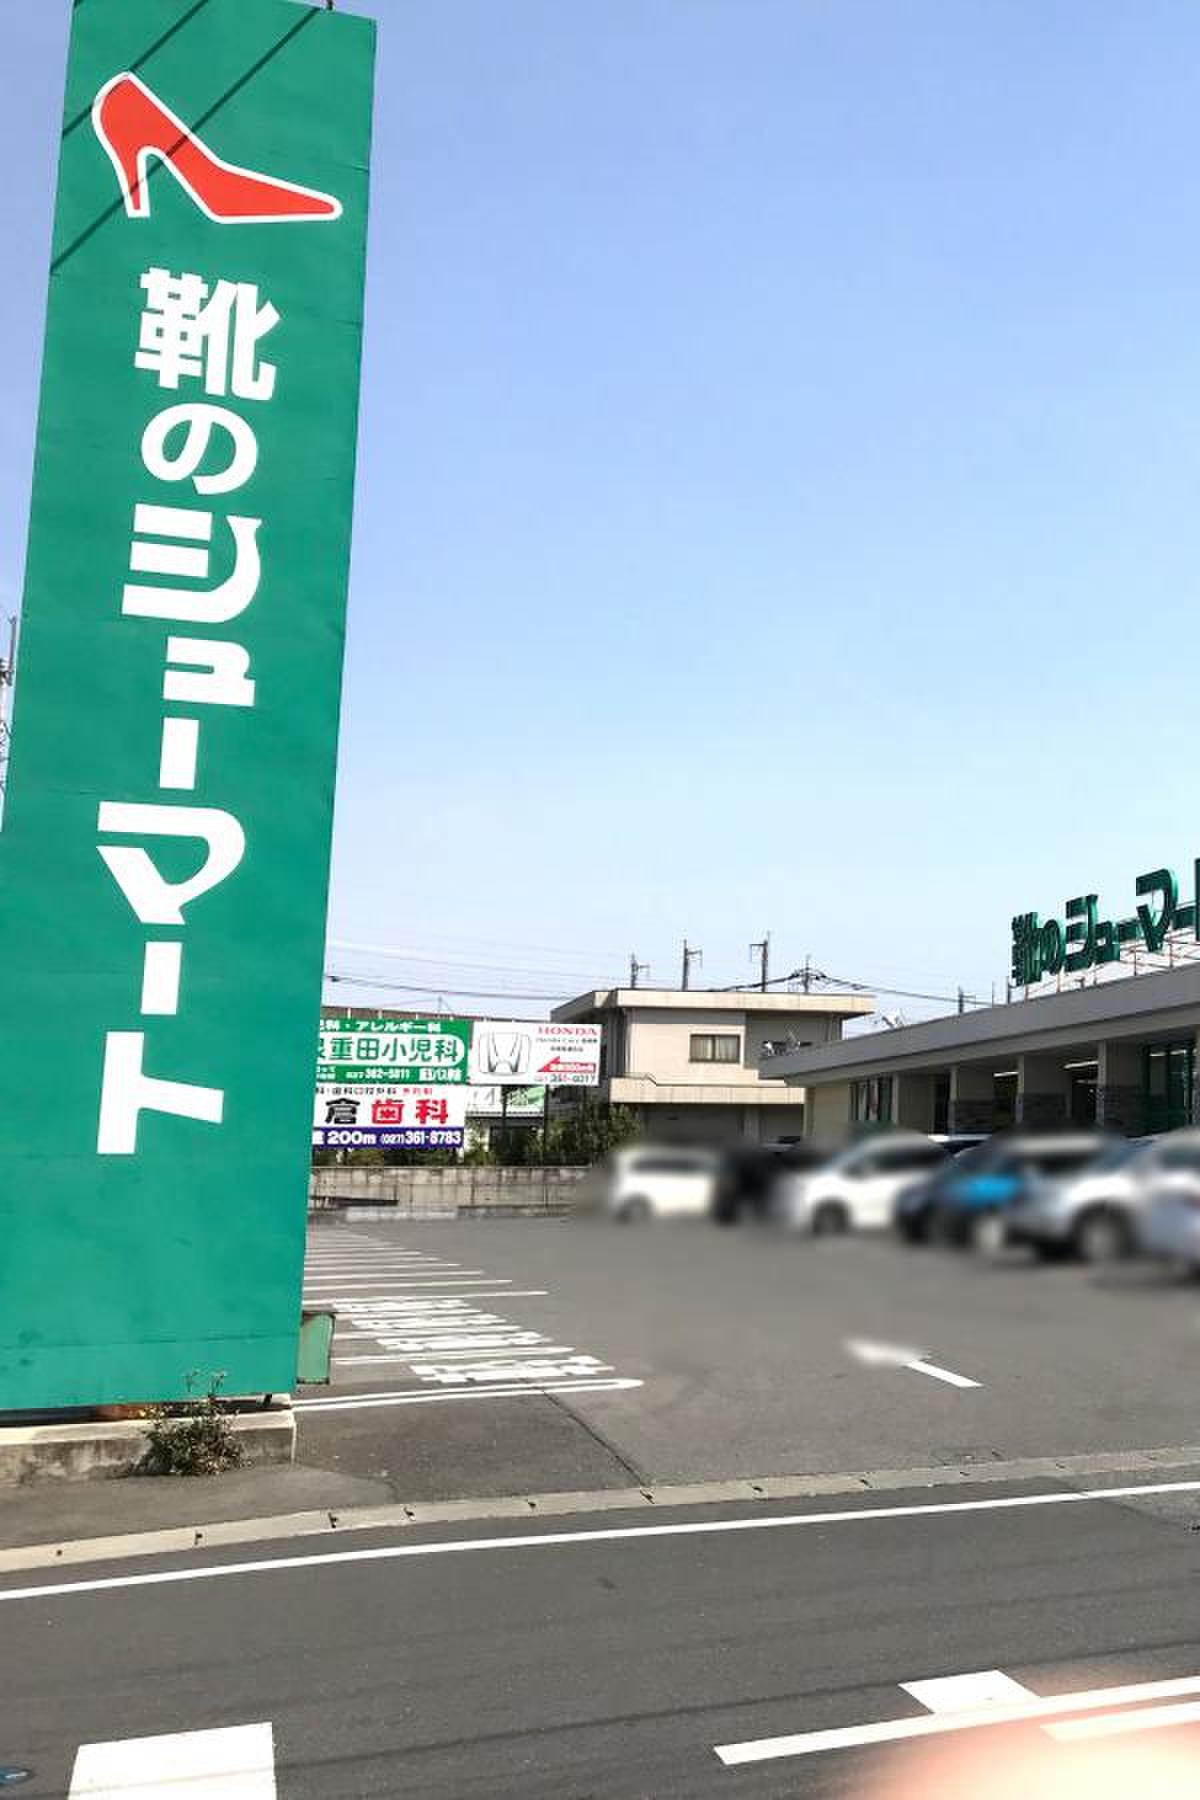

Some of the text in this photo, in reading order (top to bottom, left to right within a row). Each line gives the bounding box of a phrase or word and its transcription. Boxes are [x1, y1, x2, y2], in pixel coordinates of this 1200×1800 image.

[97, 267, 281, 1155] 靴のシューマート
[537, 1026, 598, 1036] HONDA
[327, 1131, 376, 1145] 200m
